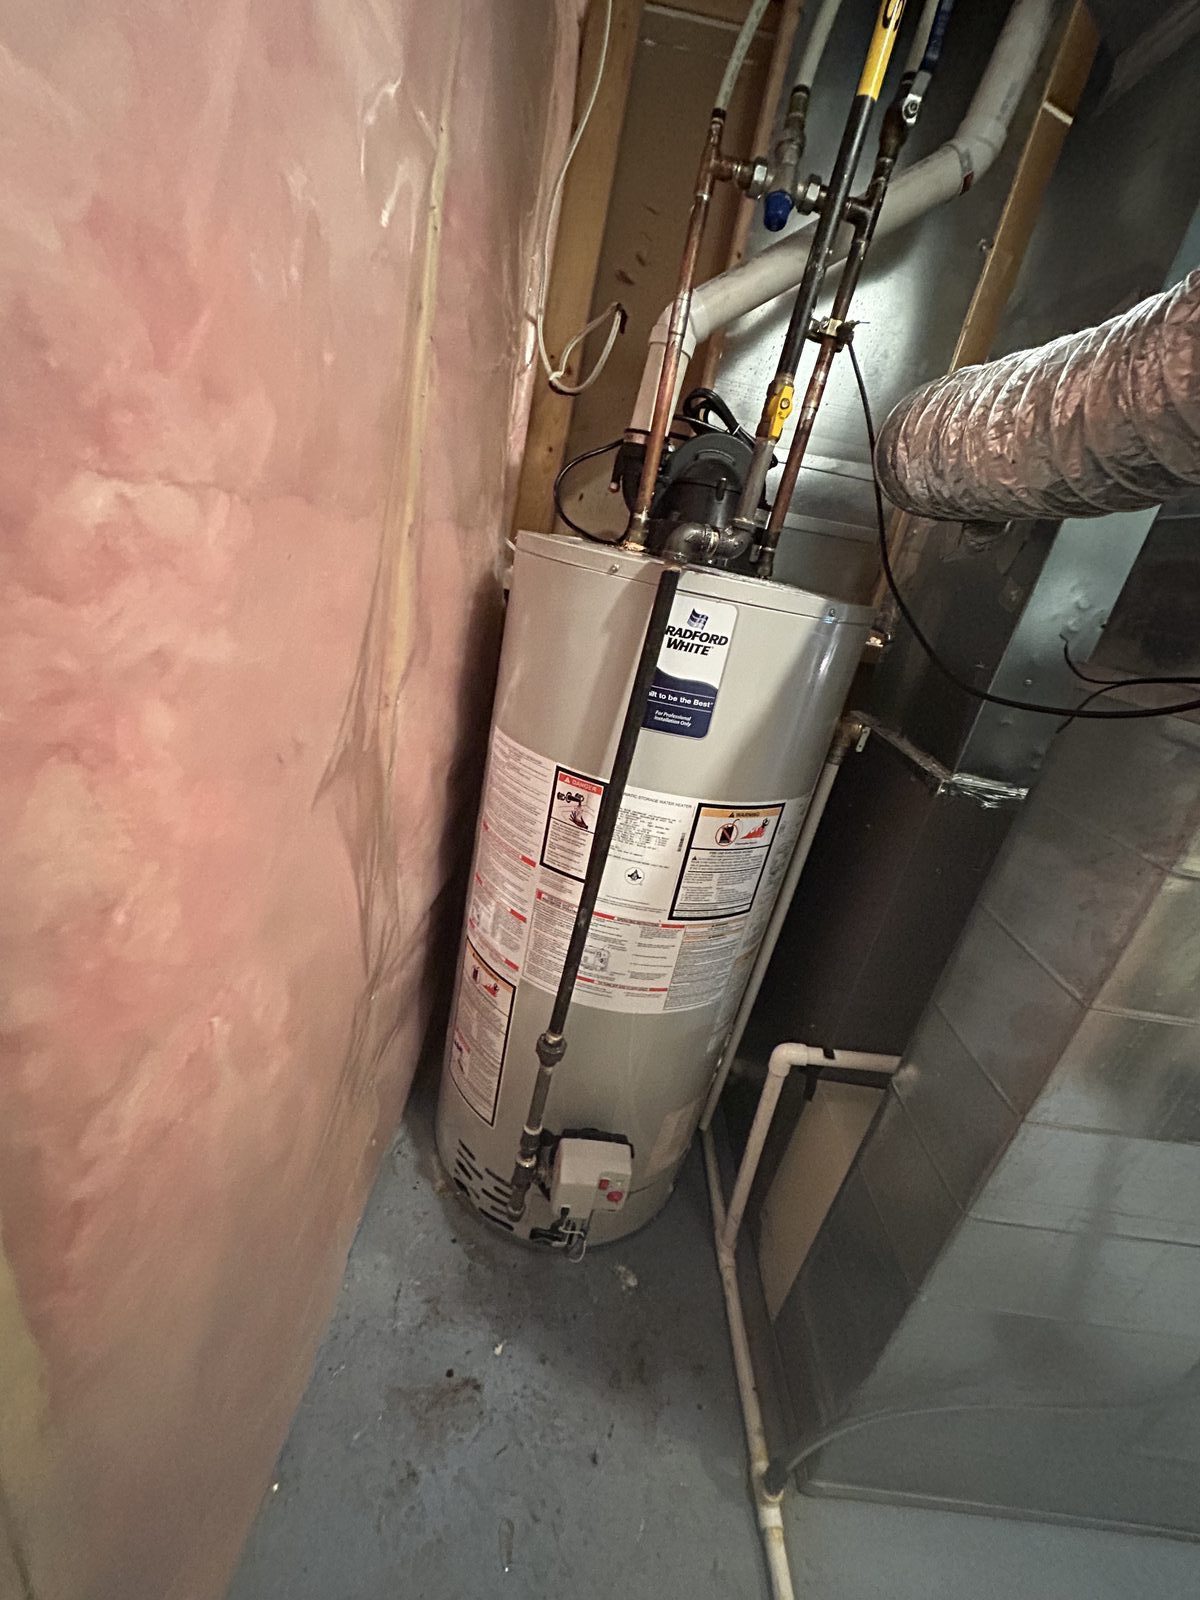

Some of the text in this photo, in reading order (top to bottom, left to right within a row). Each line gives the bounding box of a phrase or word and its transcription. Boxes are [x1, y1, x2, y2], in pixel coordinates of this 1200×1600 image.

[665, 625, 728, 645] RADFORD
[666, 637, 711, 655] WHITE
[658, 692, 667, 700] to
[667, 694, 678, 702] be
[679, 697, 692, 705] the
[693, 699, 711, 708] Best
[663, 712, 691, 721] Professional
[571, 779, 598, 792] DANGER
[638, 795, 659, 803] STORAGE
